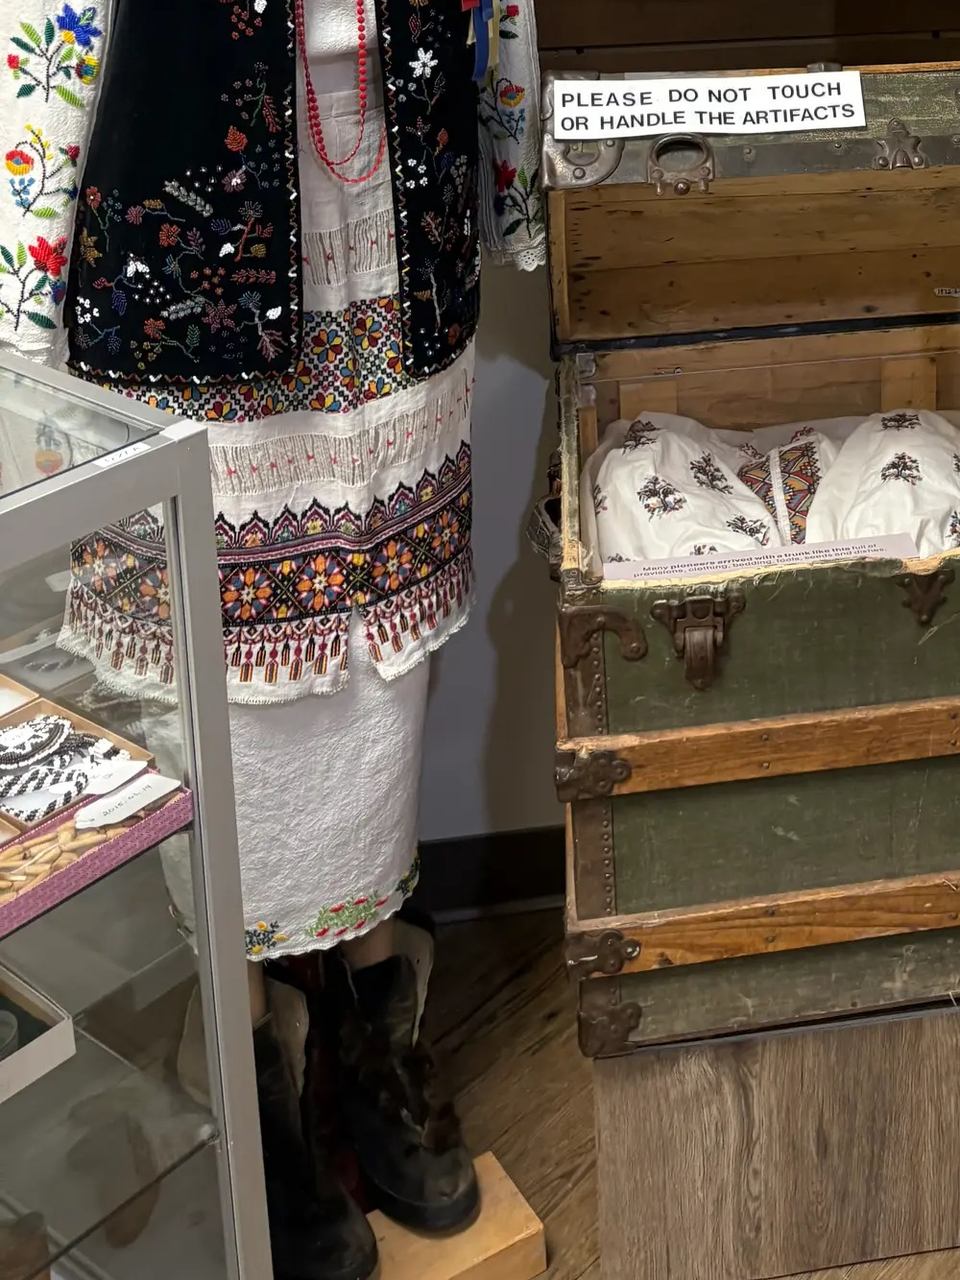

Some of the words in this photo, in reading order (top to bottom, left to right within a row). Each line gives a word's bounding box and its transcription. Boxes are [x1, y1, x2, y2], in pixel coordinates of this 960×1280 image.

[561, 91, 653, 108] PLEASE
[668, 88, 699, 102] DO
[708, 87, 751, 103] NOT
[767, 82, 842, 100] TOUCH
[560, 116, 589, 131] OR
[600, 111, 686, 130] HANDLE
[695, 110, 736, 125] THE
[743, 104, 855, 125] ARTIFACTS
